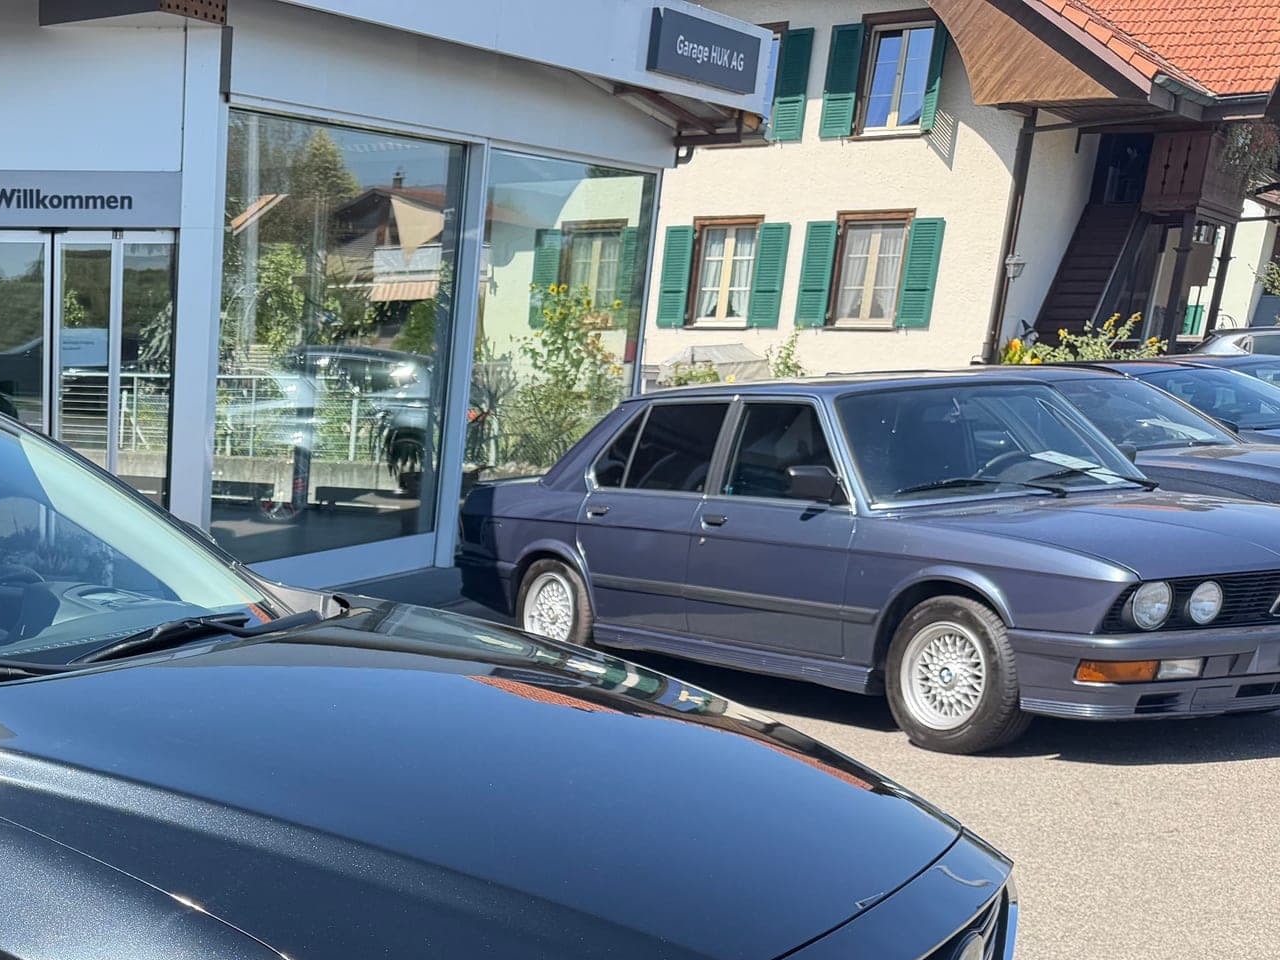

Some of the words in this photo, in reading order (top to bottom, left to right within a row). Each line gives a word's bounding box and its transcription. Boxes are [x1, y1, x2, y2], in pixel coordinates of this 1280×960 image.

[677, 35, 709, 64] Garage
[711, 45, 730, 68] HUK
[730, 51, 744, 71] AG
